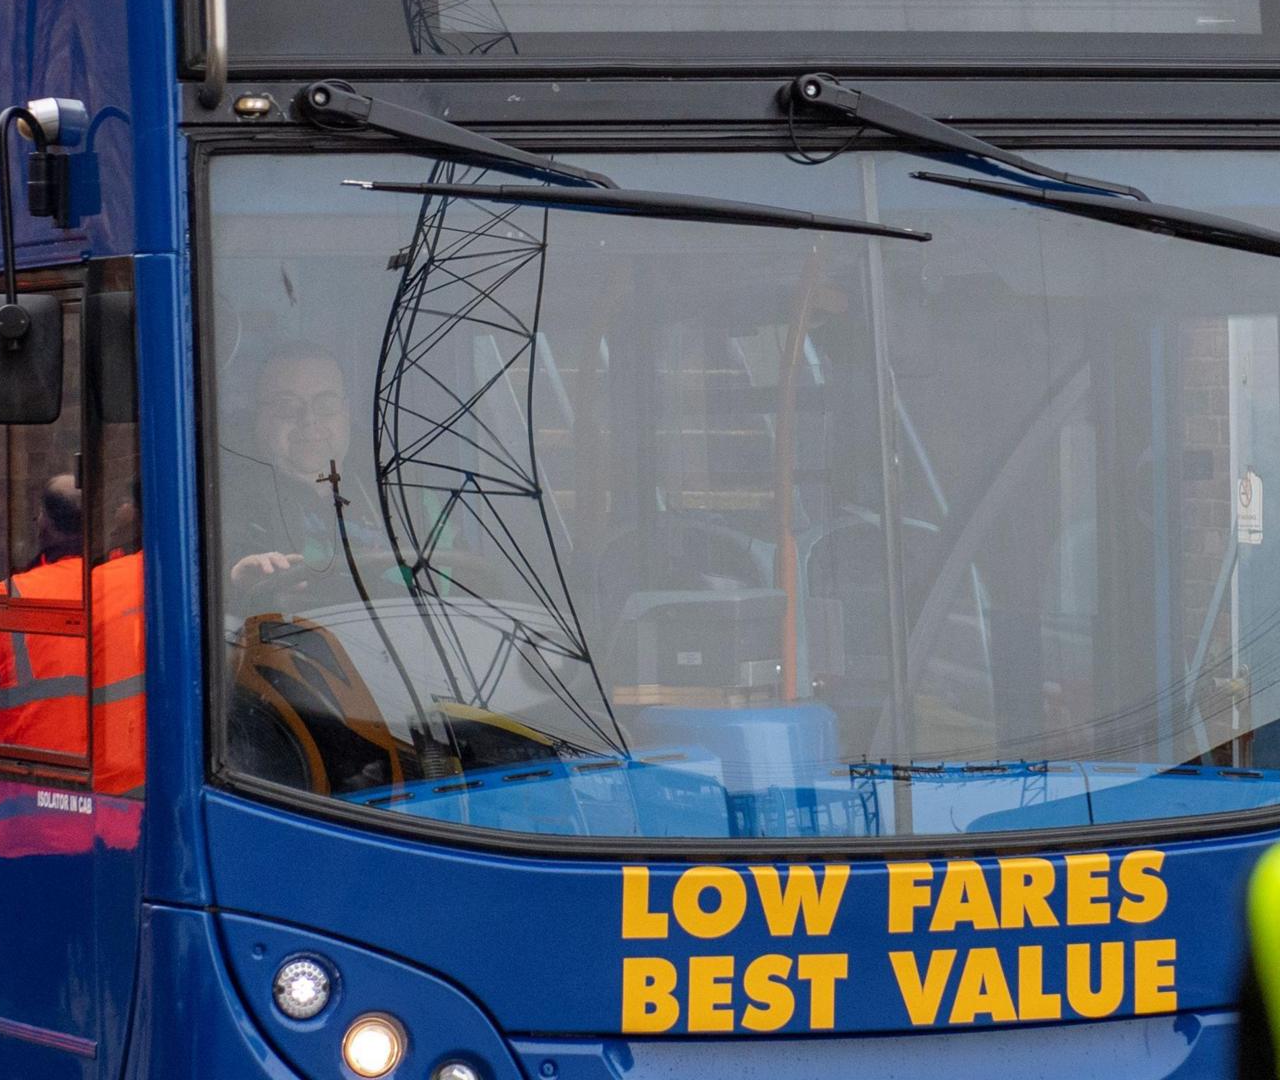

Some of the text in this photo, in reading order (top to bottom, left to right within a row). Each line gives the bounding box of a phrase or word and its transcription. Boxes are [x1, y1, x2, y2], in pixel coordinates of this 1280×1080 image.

[37, 790, 93, 814] ISOLATOR IN CAB
[622, 850, 1169, 940] LOW FARES
[622, 938, 1179, 1034] BEST VALUE
